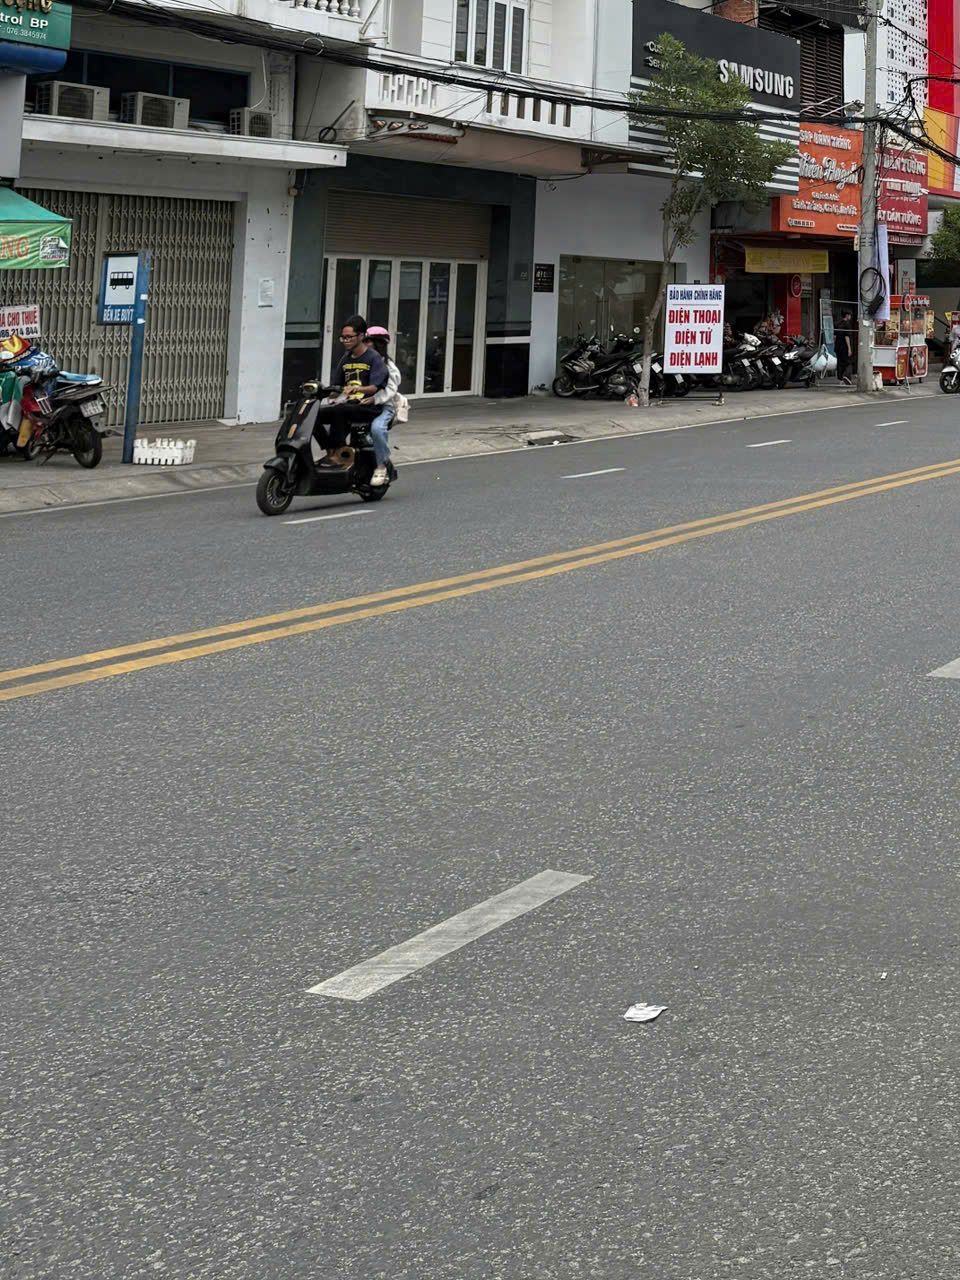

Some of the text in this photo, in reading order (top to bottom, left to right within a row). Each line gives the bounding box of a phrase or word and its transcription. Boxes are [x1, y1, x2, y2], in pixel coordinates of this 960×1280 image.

[30, 17, 49, 29] BP
[669, 307, 721, 326] ĐIỆN THOẠI
[675, 326, 713, 347] ĐIỆN TỬ
[670, 349, 718, 368] ĐIỆN LẠNH
